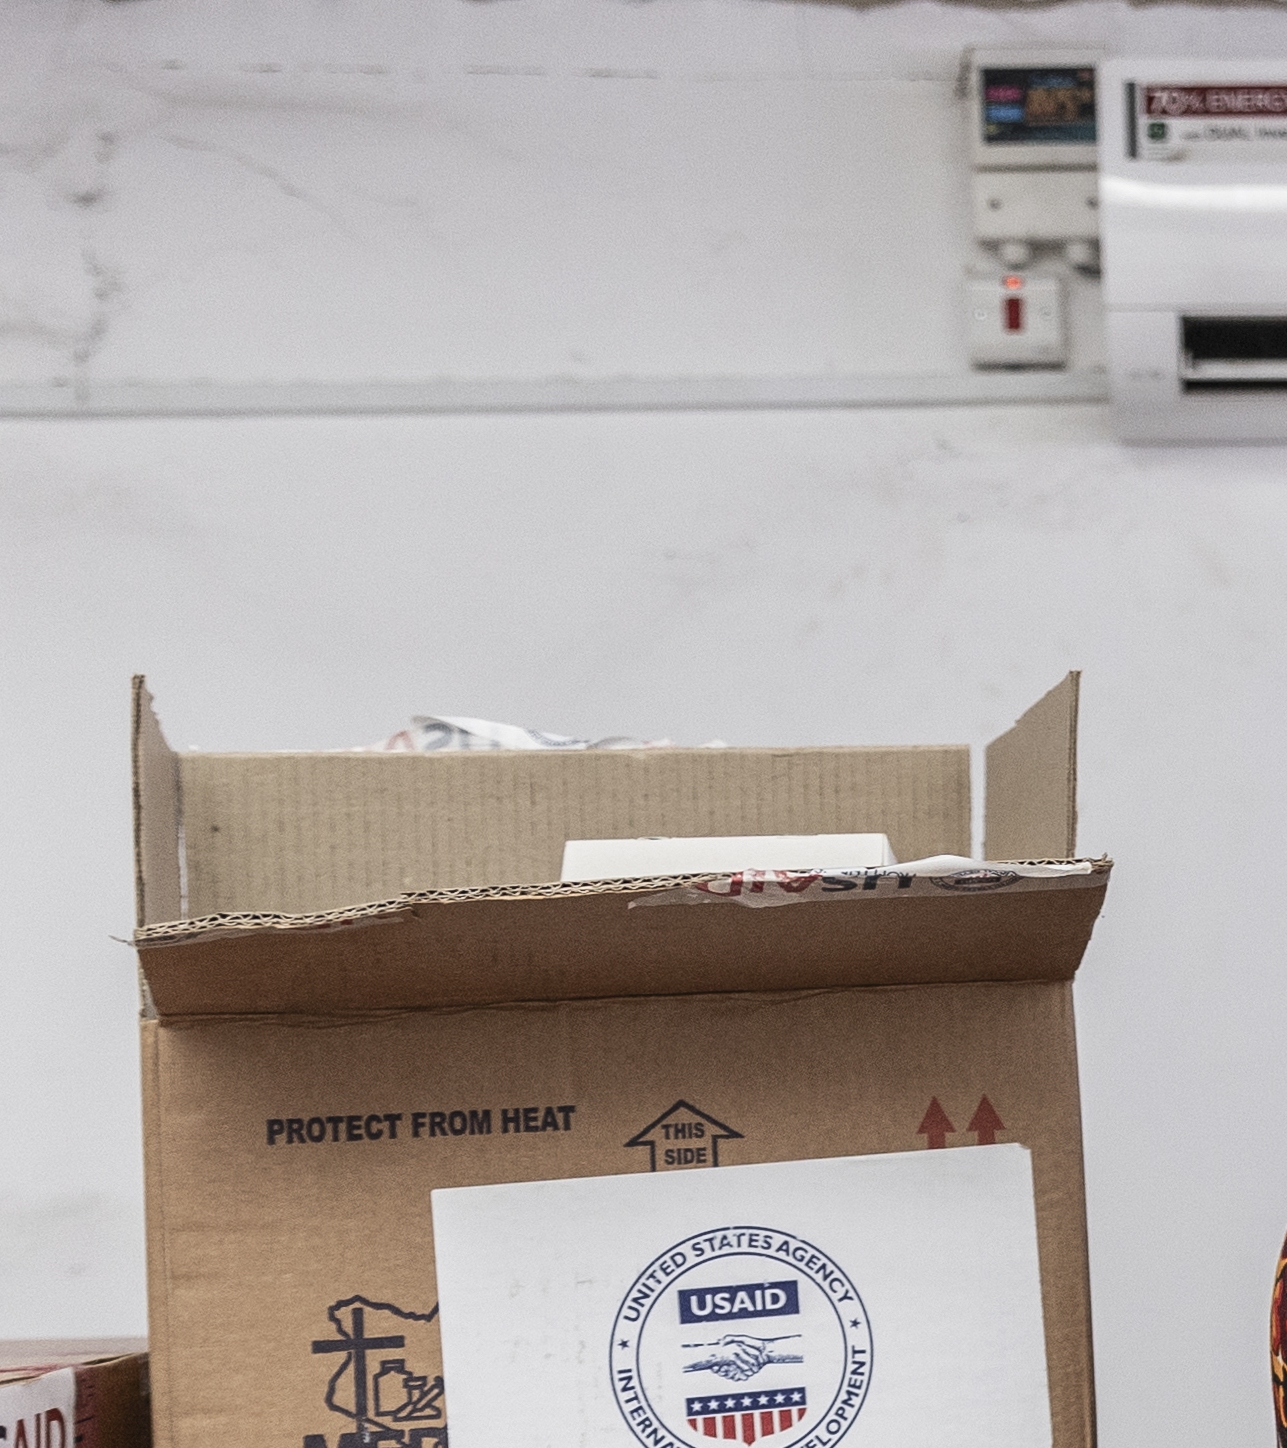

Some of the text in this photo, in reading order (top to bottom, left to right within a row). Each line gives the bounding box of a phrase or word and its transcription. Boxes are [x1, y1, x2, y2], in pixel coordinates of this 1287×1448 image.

[266, 1105, 576, 1145] PROTECT FROM HEAT
[662, 1122, 705, 1141] THIS
[664, 1147, 707, 1166] SIDE
[623, 1233, 854, 1322] UNITED STATES AGENCY
[690, 1288, 787, 1316] USAID
